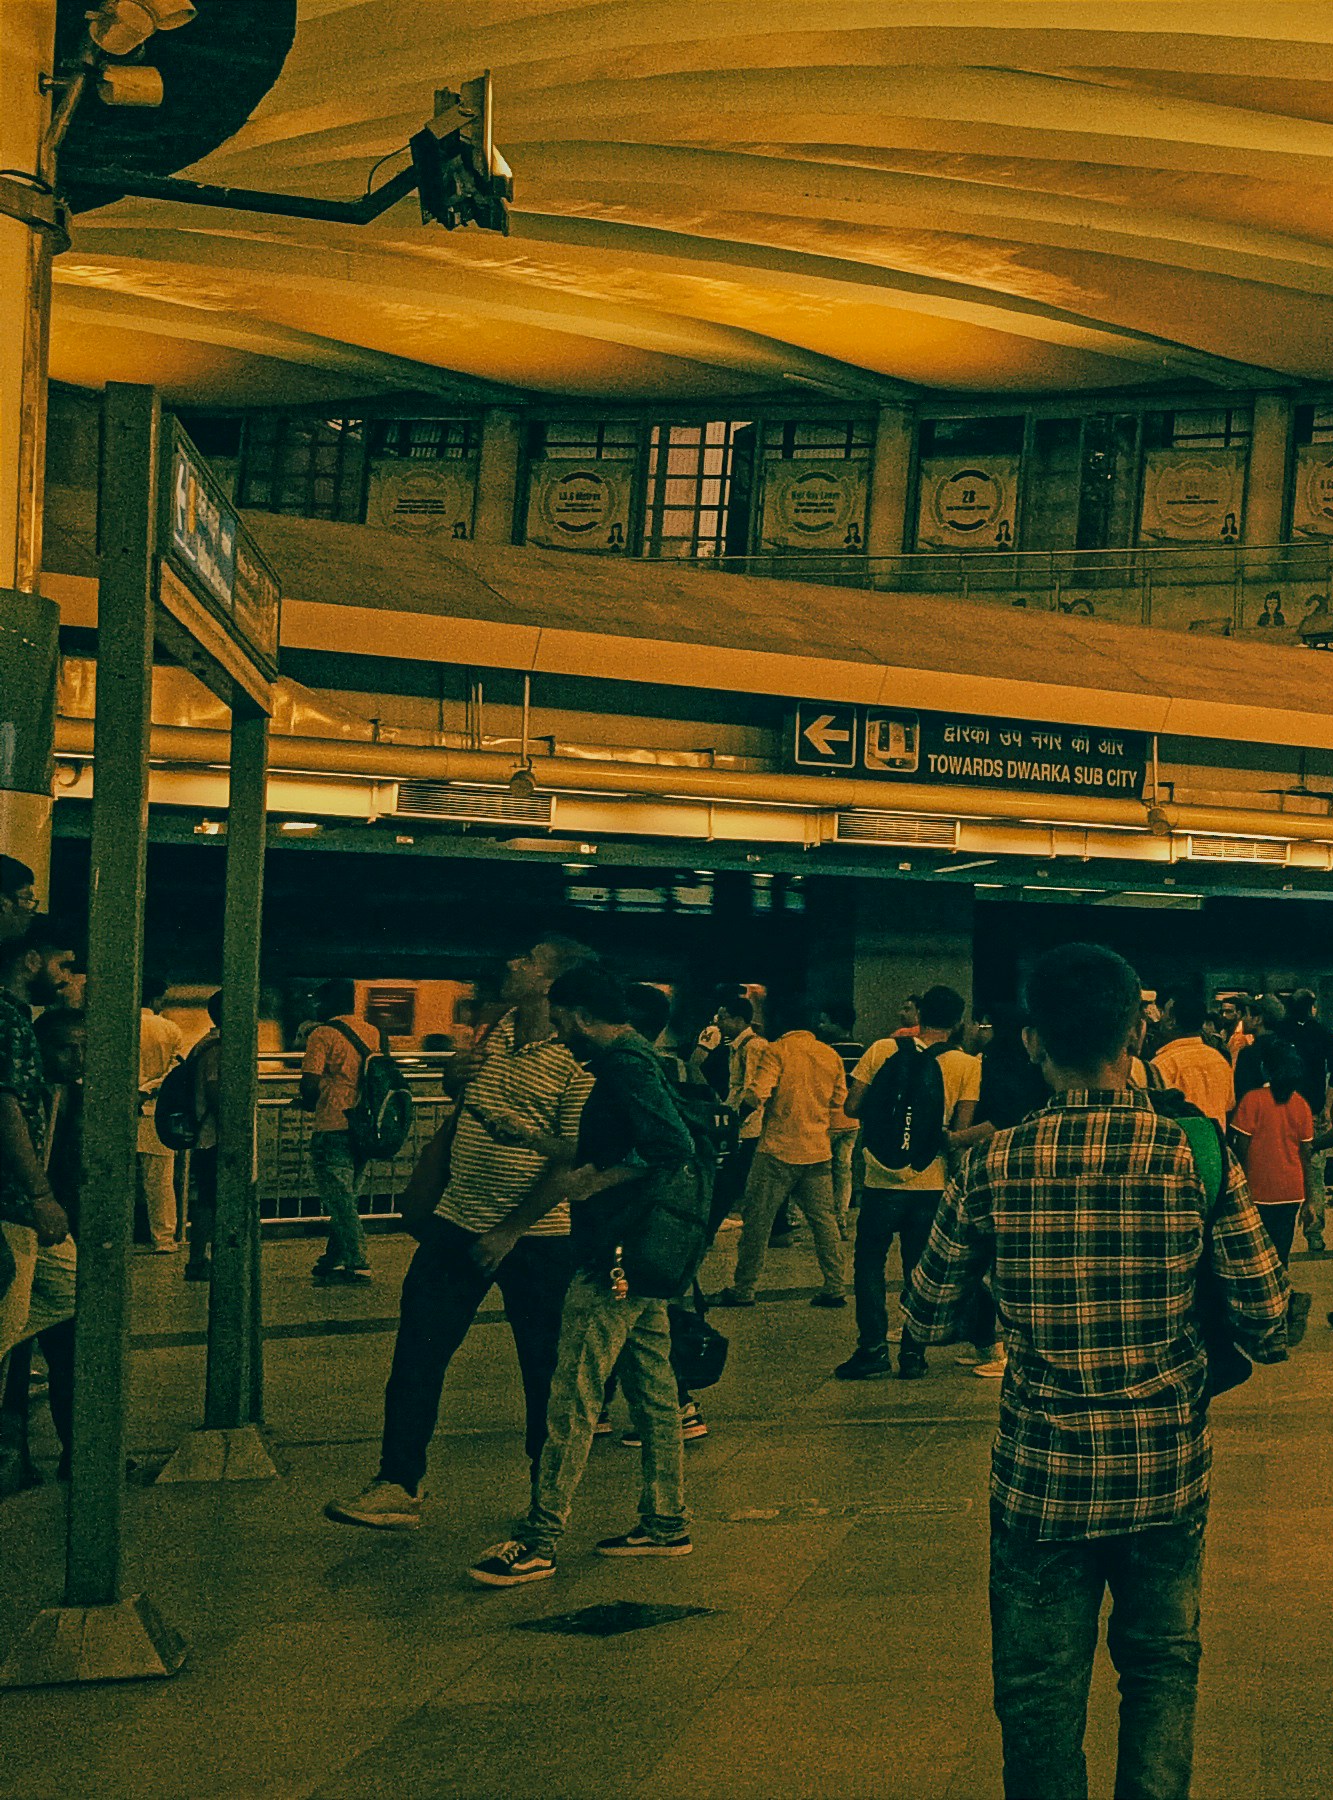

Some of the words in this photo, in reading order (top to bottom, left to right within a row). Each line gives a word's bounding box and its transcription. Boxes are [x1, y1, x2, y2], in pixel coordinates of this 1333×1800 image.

[944, 722, 991, 746] द्वारका
[999, 727, 1023, 748] उप
[1030, 732, 1063, 751] नगर
[1071, 728, 1091, 756] की
[1098, 732, 1125, 756] ओर
[927, 753, 1004, 779] TOWARDS
[1007, 759, 1071, 784] DWARKA
[1073, 766, 1103, 787] SUB
[1106, 768, 1138, 789] CITY
